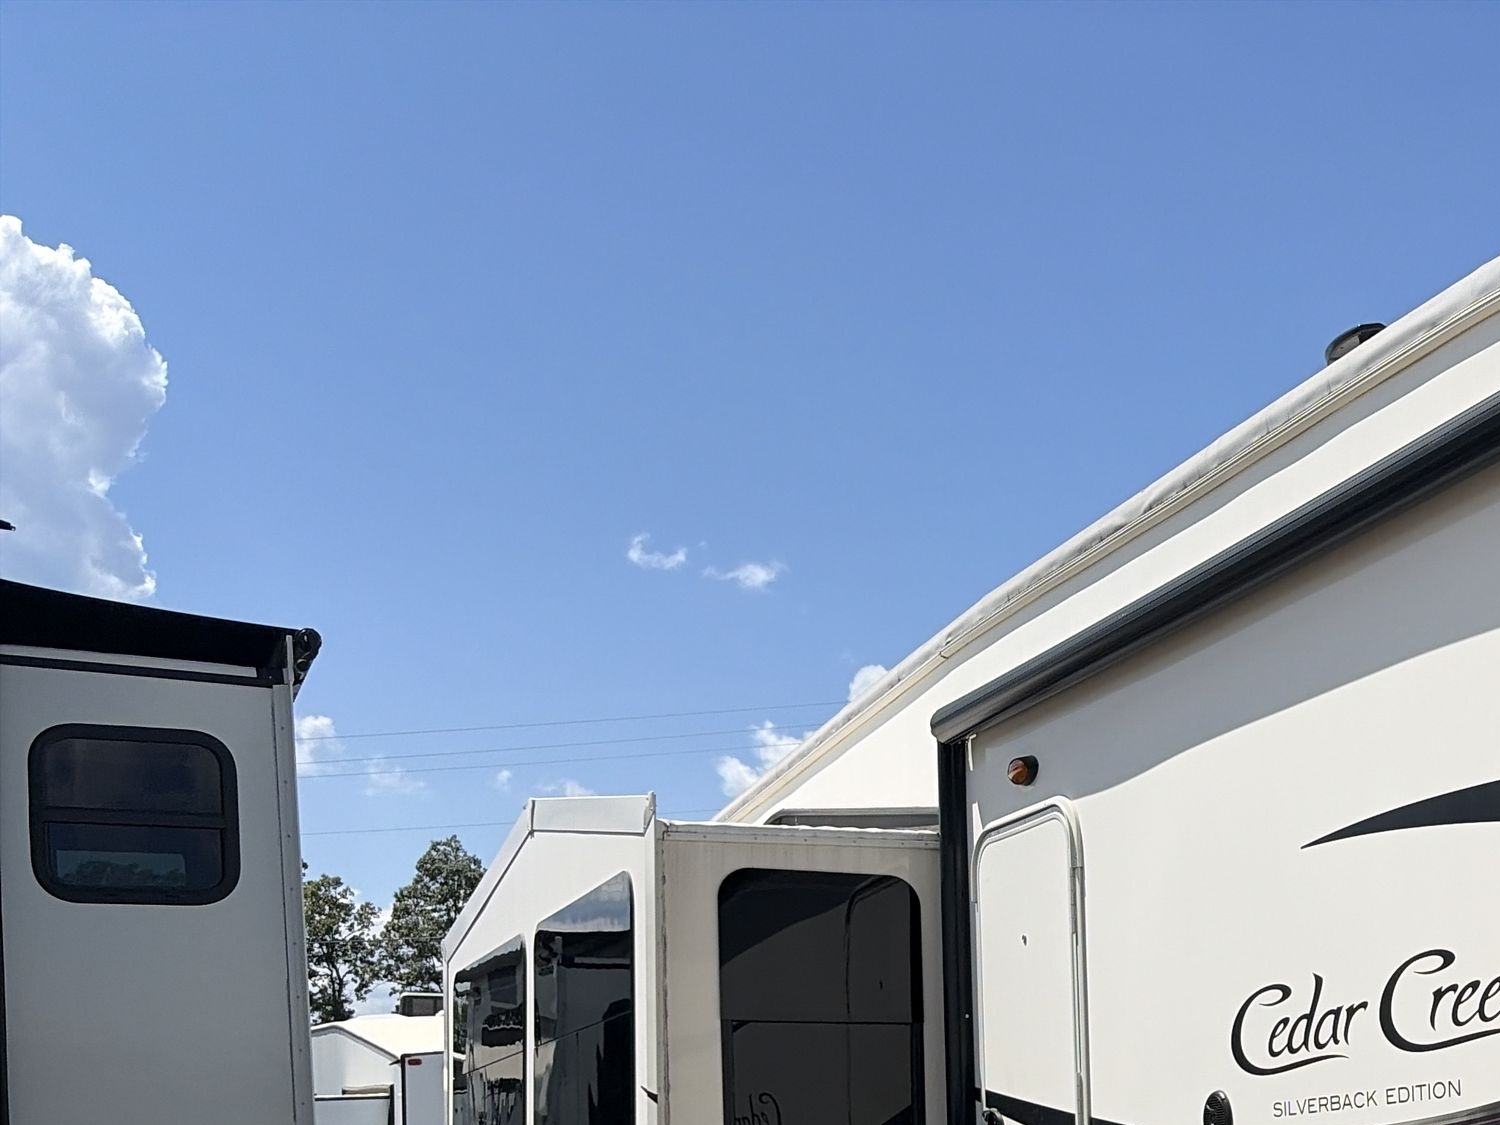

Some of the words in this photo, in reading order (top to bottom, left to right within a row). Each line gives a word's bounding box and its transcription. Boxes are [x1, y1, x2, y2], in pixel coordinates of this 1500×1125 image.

[1231, 973, 1368, 1076] Cedar
[1274, 1090, 1377, 1117] SILVERBACK
[1386, 1080, 1461, 1104] EDITION
